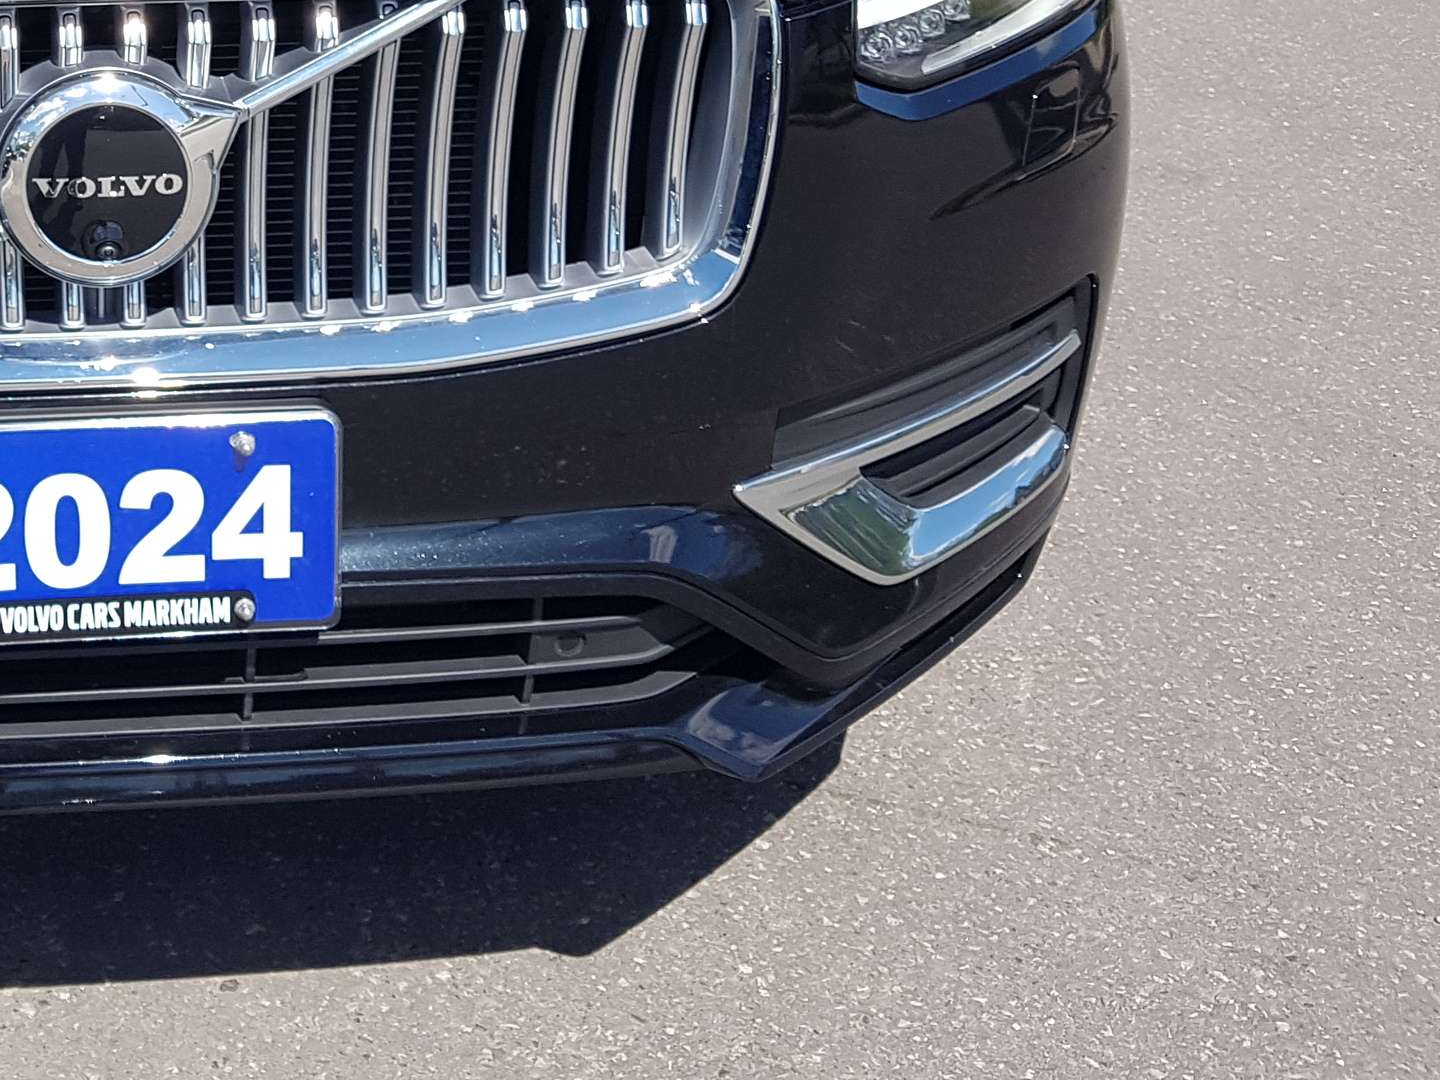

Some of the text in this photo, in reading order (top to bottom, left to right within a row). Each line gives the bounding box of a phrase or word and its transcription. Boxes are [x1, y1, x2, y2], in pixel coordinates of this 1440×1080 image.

[32, 173, 183, 198] VOLVO
[0, 596, 231, 633] VOLVO CARS MARKHAM
